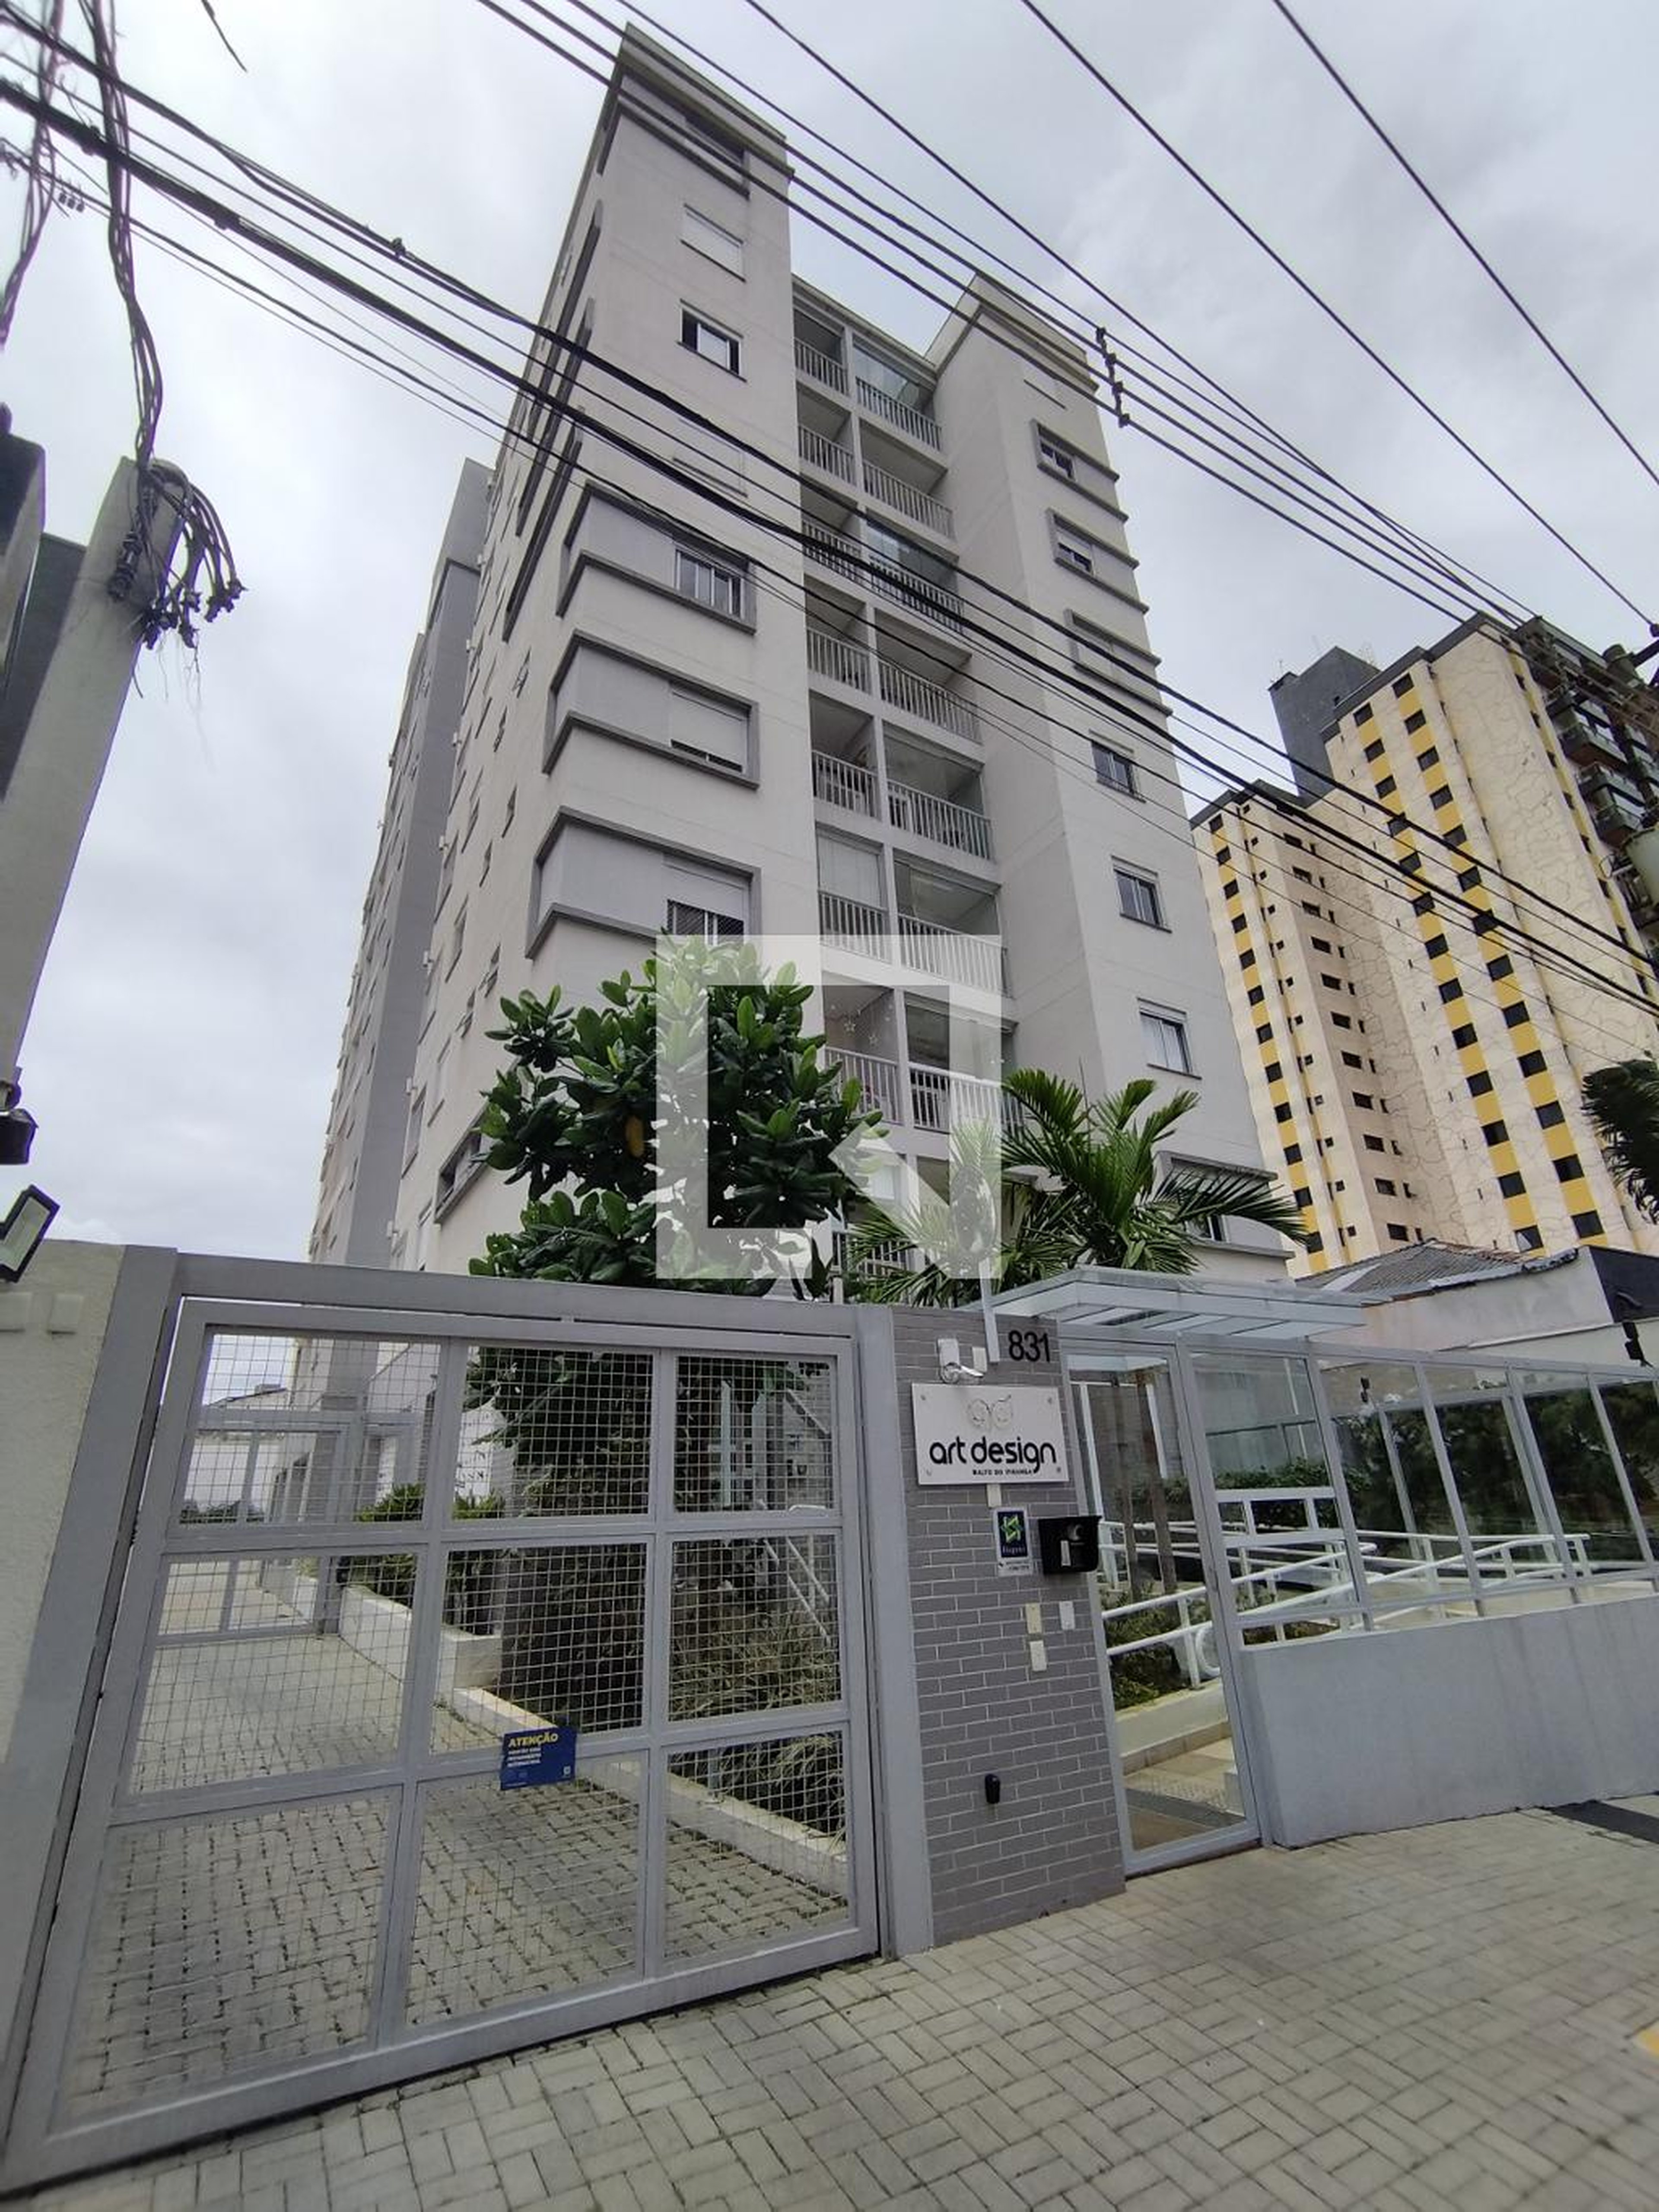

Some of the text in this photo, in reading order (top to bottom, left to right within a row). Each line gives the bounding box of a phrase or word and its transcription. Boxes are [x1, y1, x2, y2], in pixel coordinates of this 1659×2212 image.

[1009, 1330, 1050, 1362] 831
[929, 1436, 1056, 1473] art design
[508, 1731, 559, 1747] ATENÇÃO
